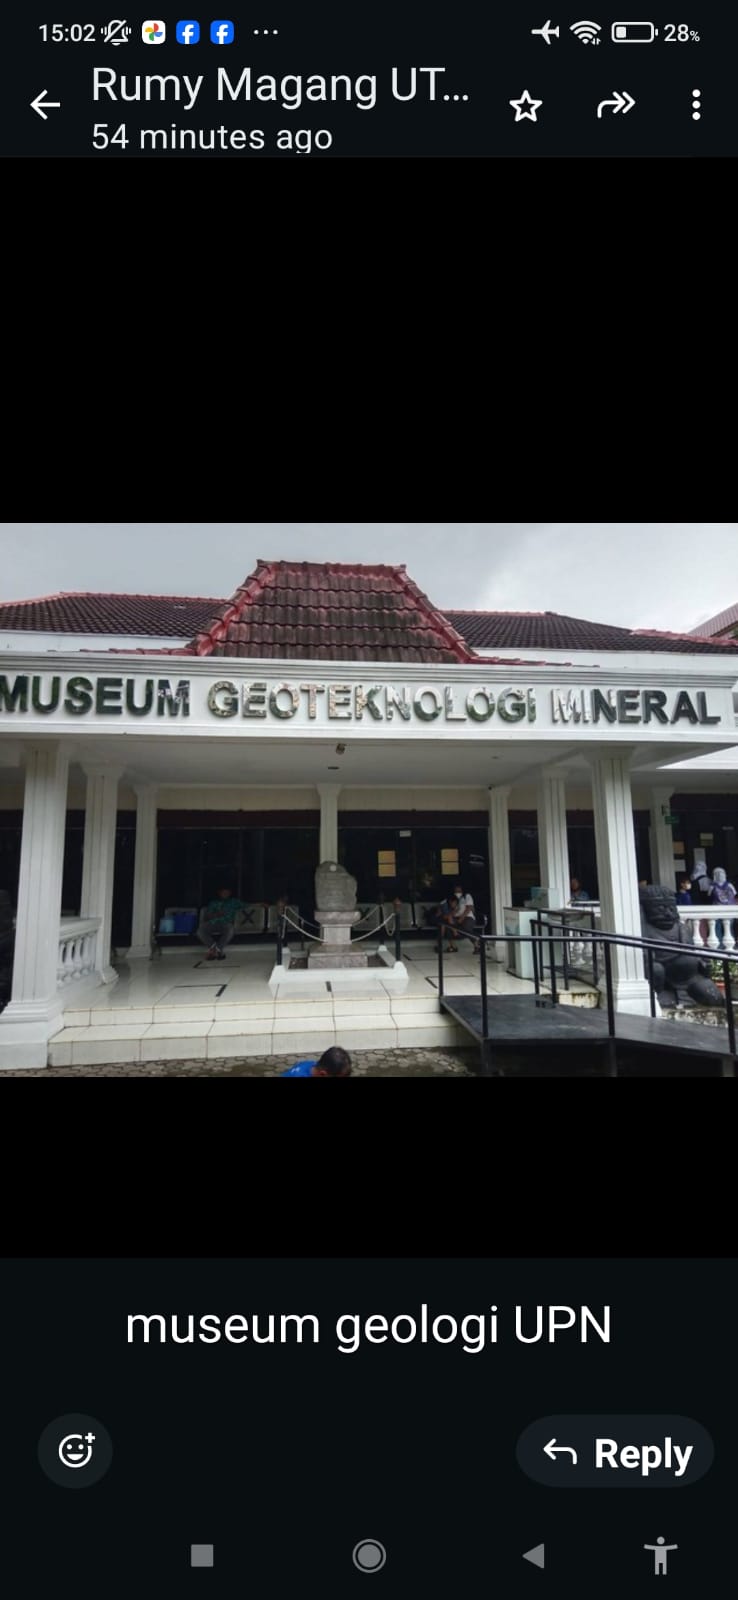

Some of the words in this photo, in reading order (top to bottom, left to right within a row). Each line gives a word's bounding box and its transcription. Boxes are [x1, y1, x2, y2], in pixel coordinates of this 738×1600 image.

[0, 674, 191, 718] MUSEUM
[207, 680, 537, 723] GEOTEKNOLOGI
[551, 687, 722, 726] MINERAL
